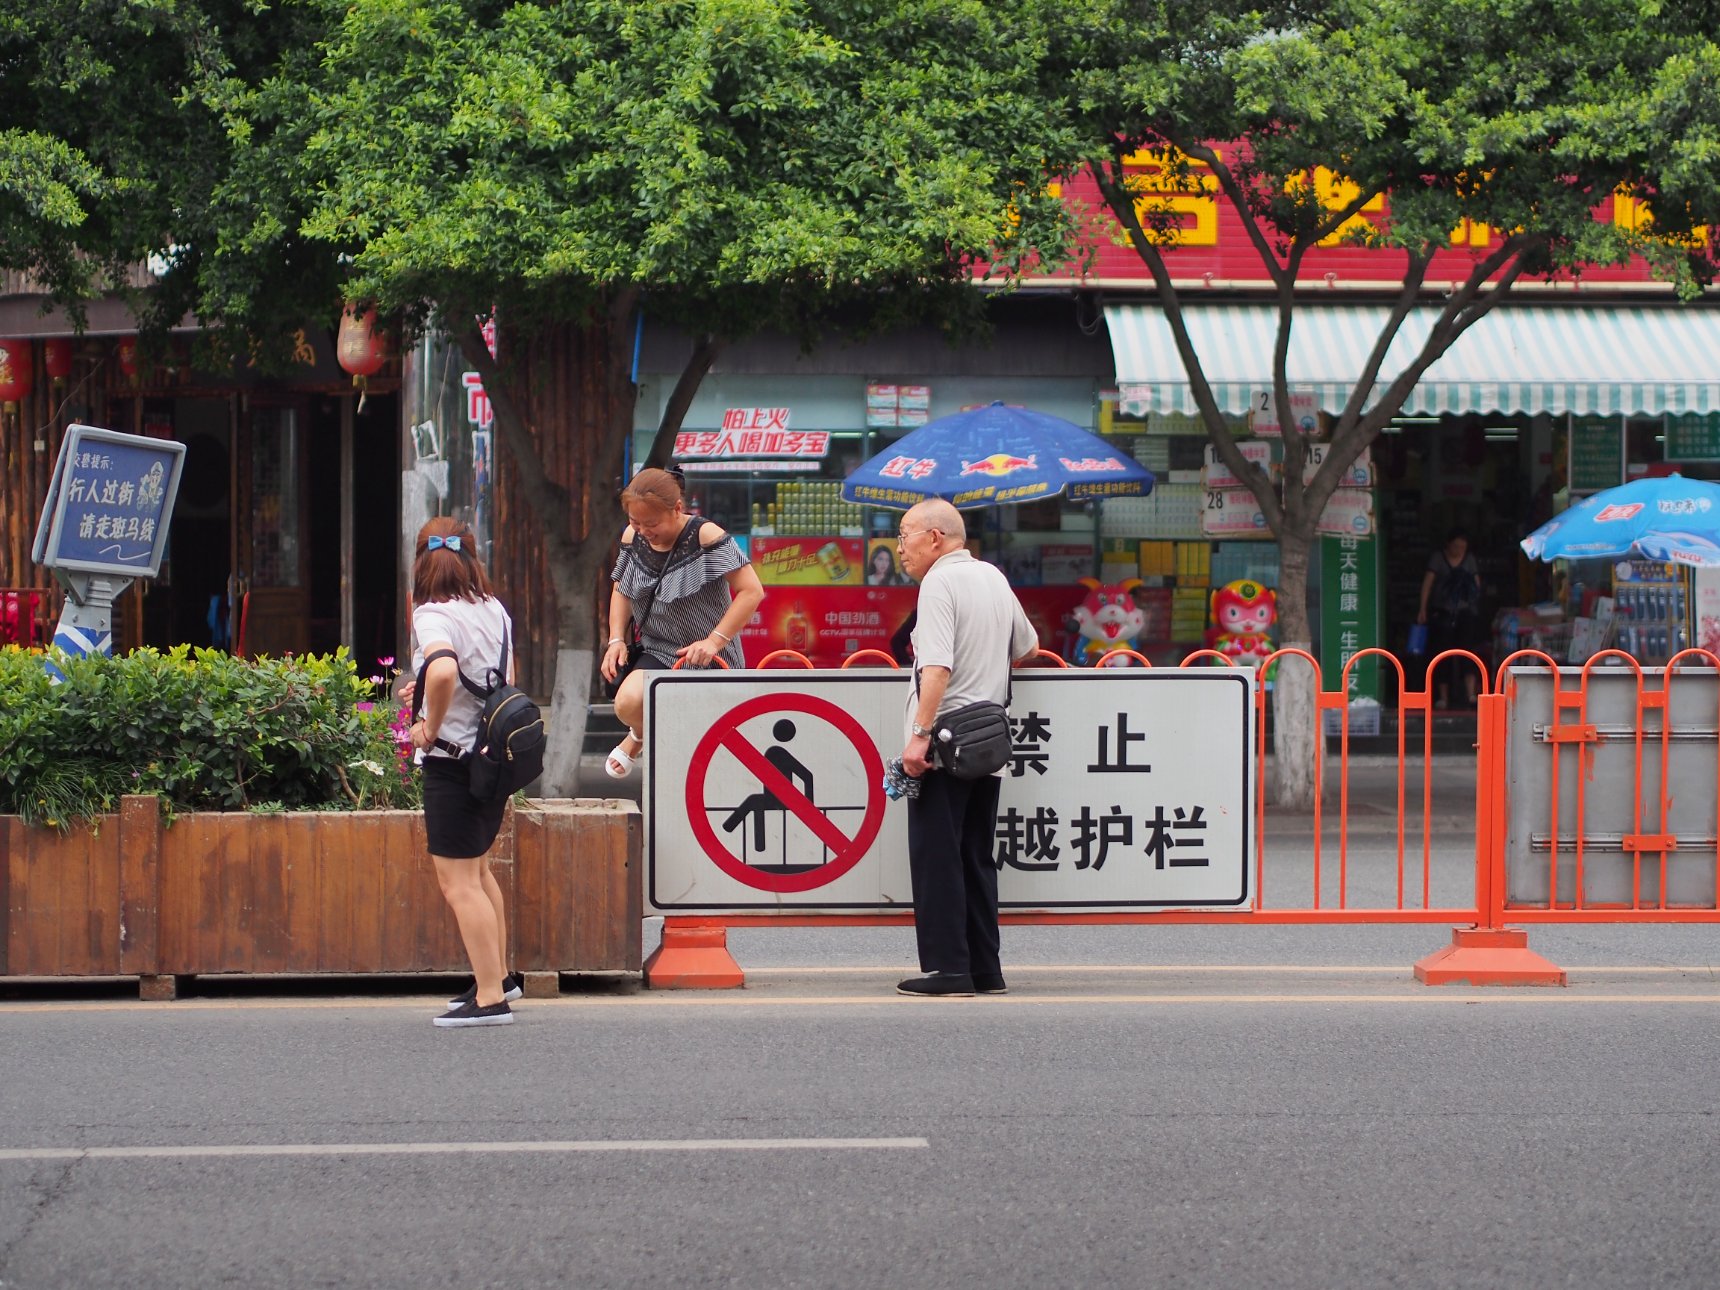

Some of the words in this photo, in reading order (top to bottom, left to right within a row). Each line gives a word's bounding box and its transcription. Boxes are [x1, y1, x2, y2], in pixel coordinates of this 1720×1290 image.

[1260, 391, 1269, 411] 2
[721, 407, 790, 430] 怕上火
[674, 431, 829, 456] 更多人喝加多宝
[879, 455, 937, 478] 红牛
[69, 477, 135, 506] 行人过街
[1207, 491, 1223, 509] 28
[79, 512, 155, 542] 请走斑马线
[825, 611, 880, 625] 中国劲酒
[996, 805, 1209, 871] 越护栏
